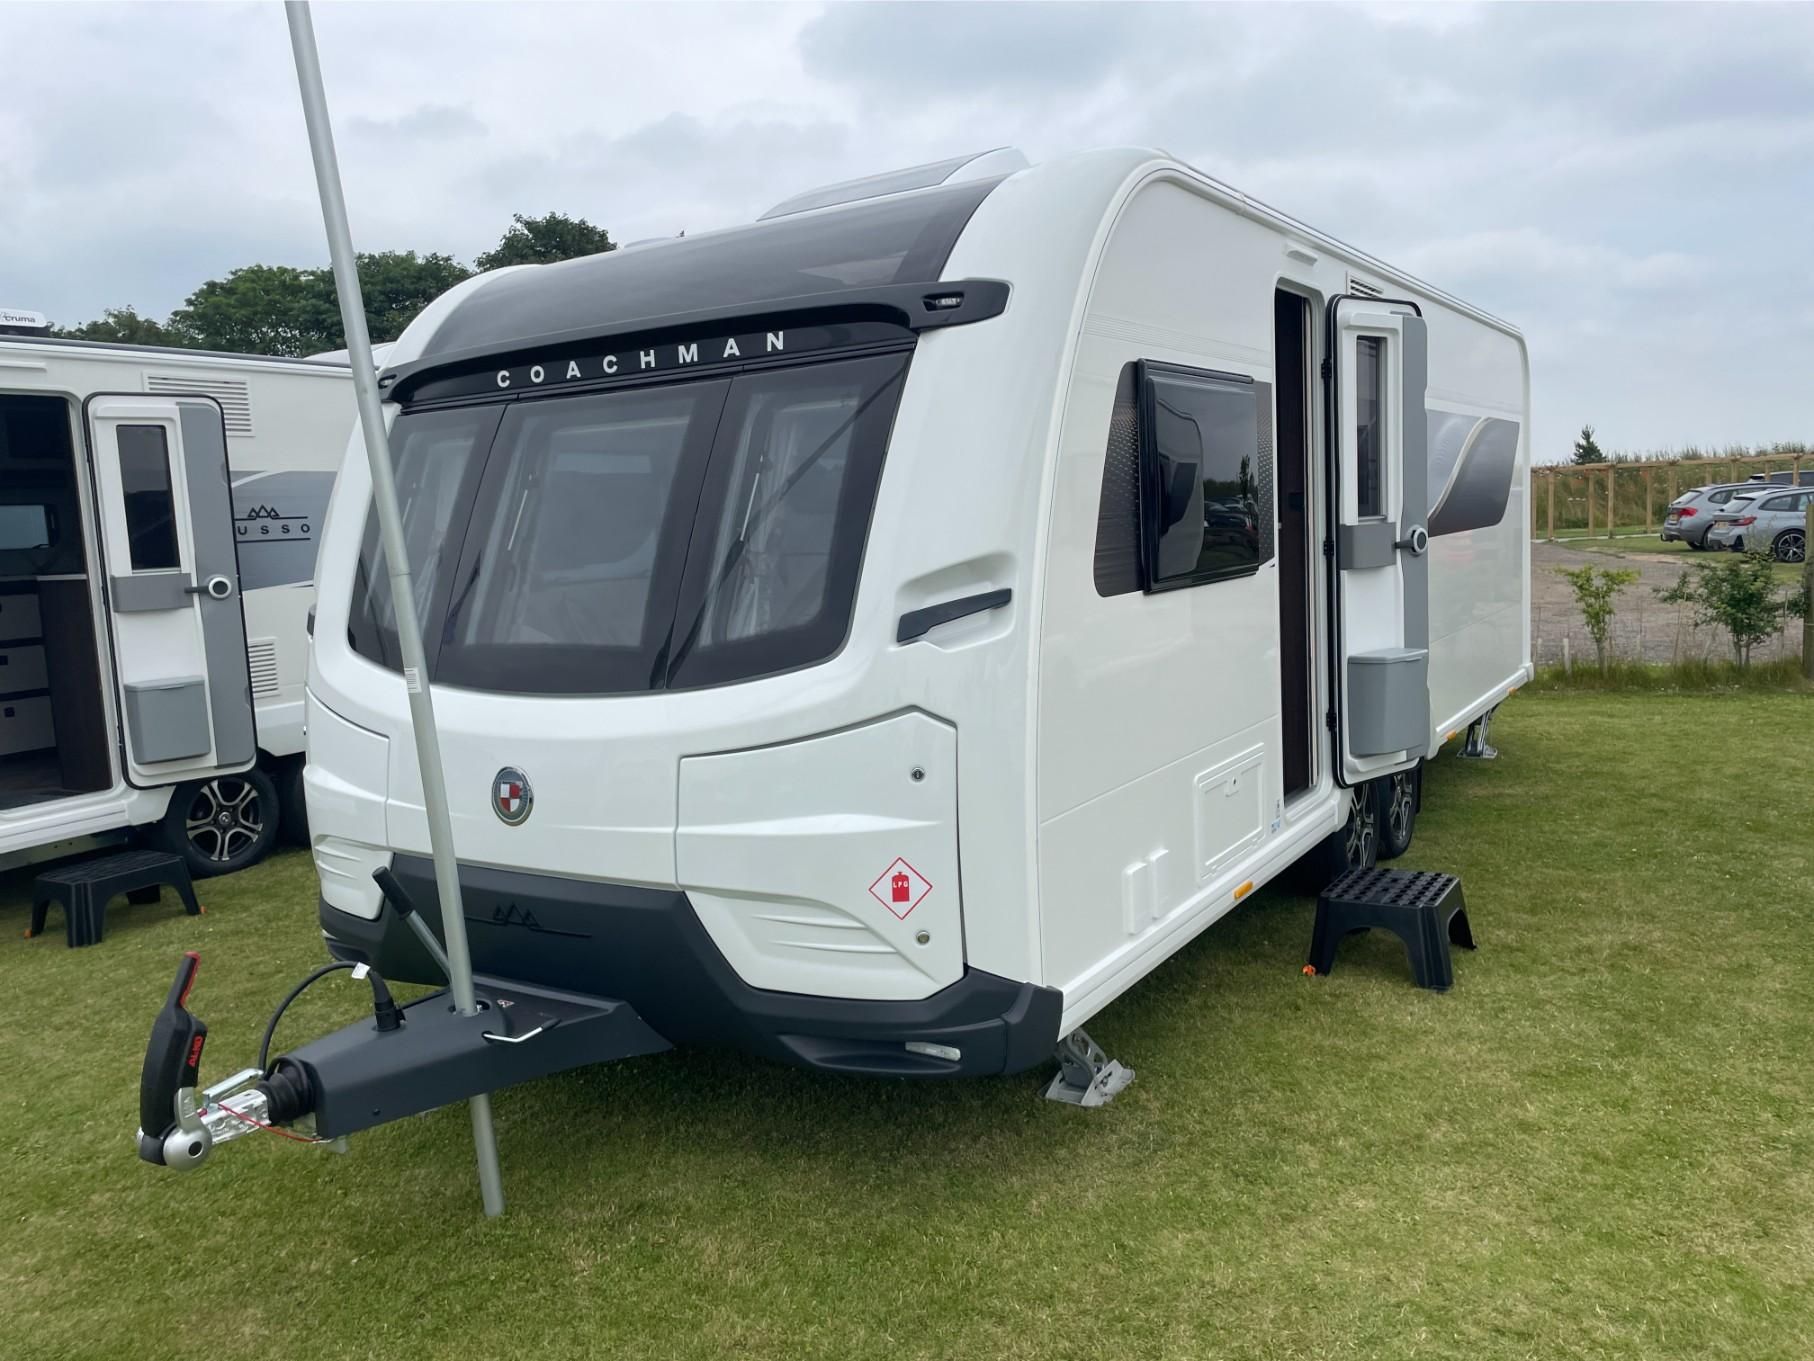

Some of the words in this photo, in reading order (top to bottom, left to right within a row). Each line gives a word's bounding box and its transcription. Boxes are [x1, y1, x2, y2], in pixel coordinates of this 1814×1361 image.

[496, 330, 785, 388] COACHMAN
[237, 523, 311, 536] USSO
[893, 880, 909, 889] LPG
